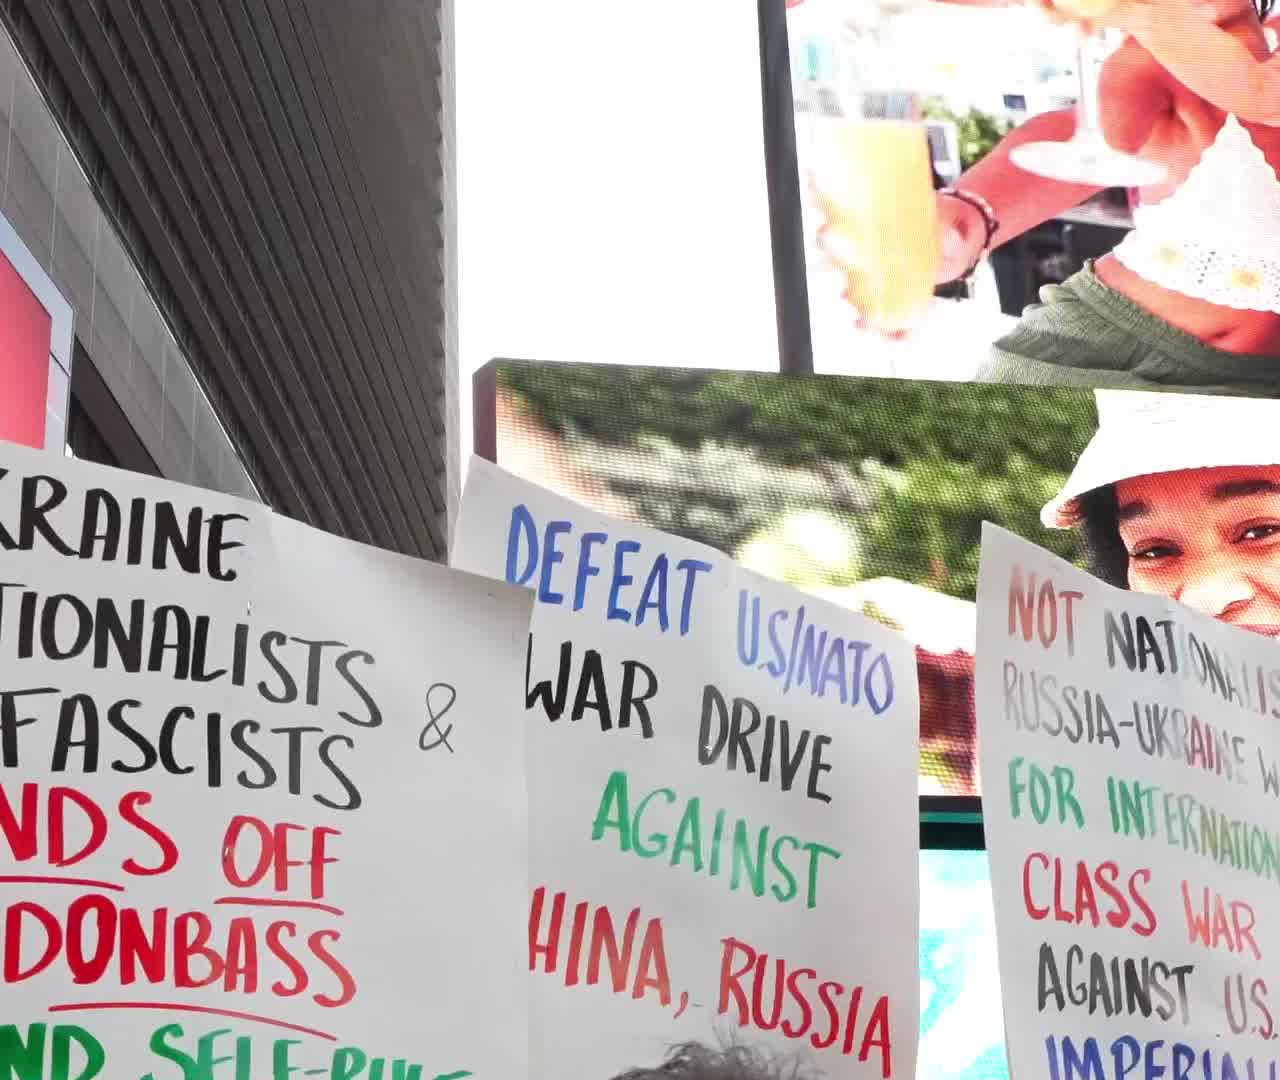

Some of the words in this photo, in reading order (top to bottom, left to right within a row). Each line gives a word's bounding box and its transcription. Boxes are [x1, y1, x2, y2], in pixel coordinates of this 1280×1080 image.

[506, 503, 713, 637] DEFEAT
[1007, 562, 1084, 657] NOT
[420, 682, 457, 754] &
[525, 632, 659, 739] WAR
[699, 684, 833, 804] DRIVE
[1003, 659, 1246, 787] RUSSIA-UKRAINE
[591, 770, 842, 909] AGAINST
[1007, 756, 1084, 830] FOR
[221, 814, 343, 901] OFF
[1022, 851, 1158, 937] CLASS
[1180, 878, 1263, 961] WAR
[3, 895, 358, 1008] DONBASS
[527, 885, 690, 1020] HINA,
[717, 936, 892, 1079] RUSSIA
[1037, 941, 1195, 1025] AGAINST
